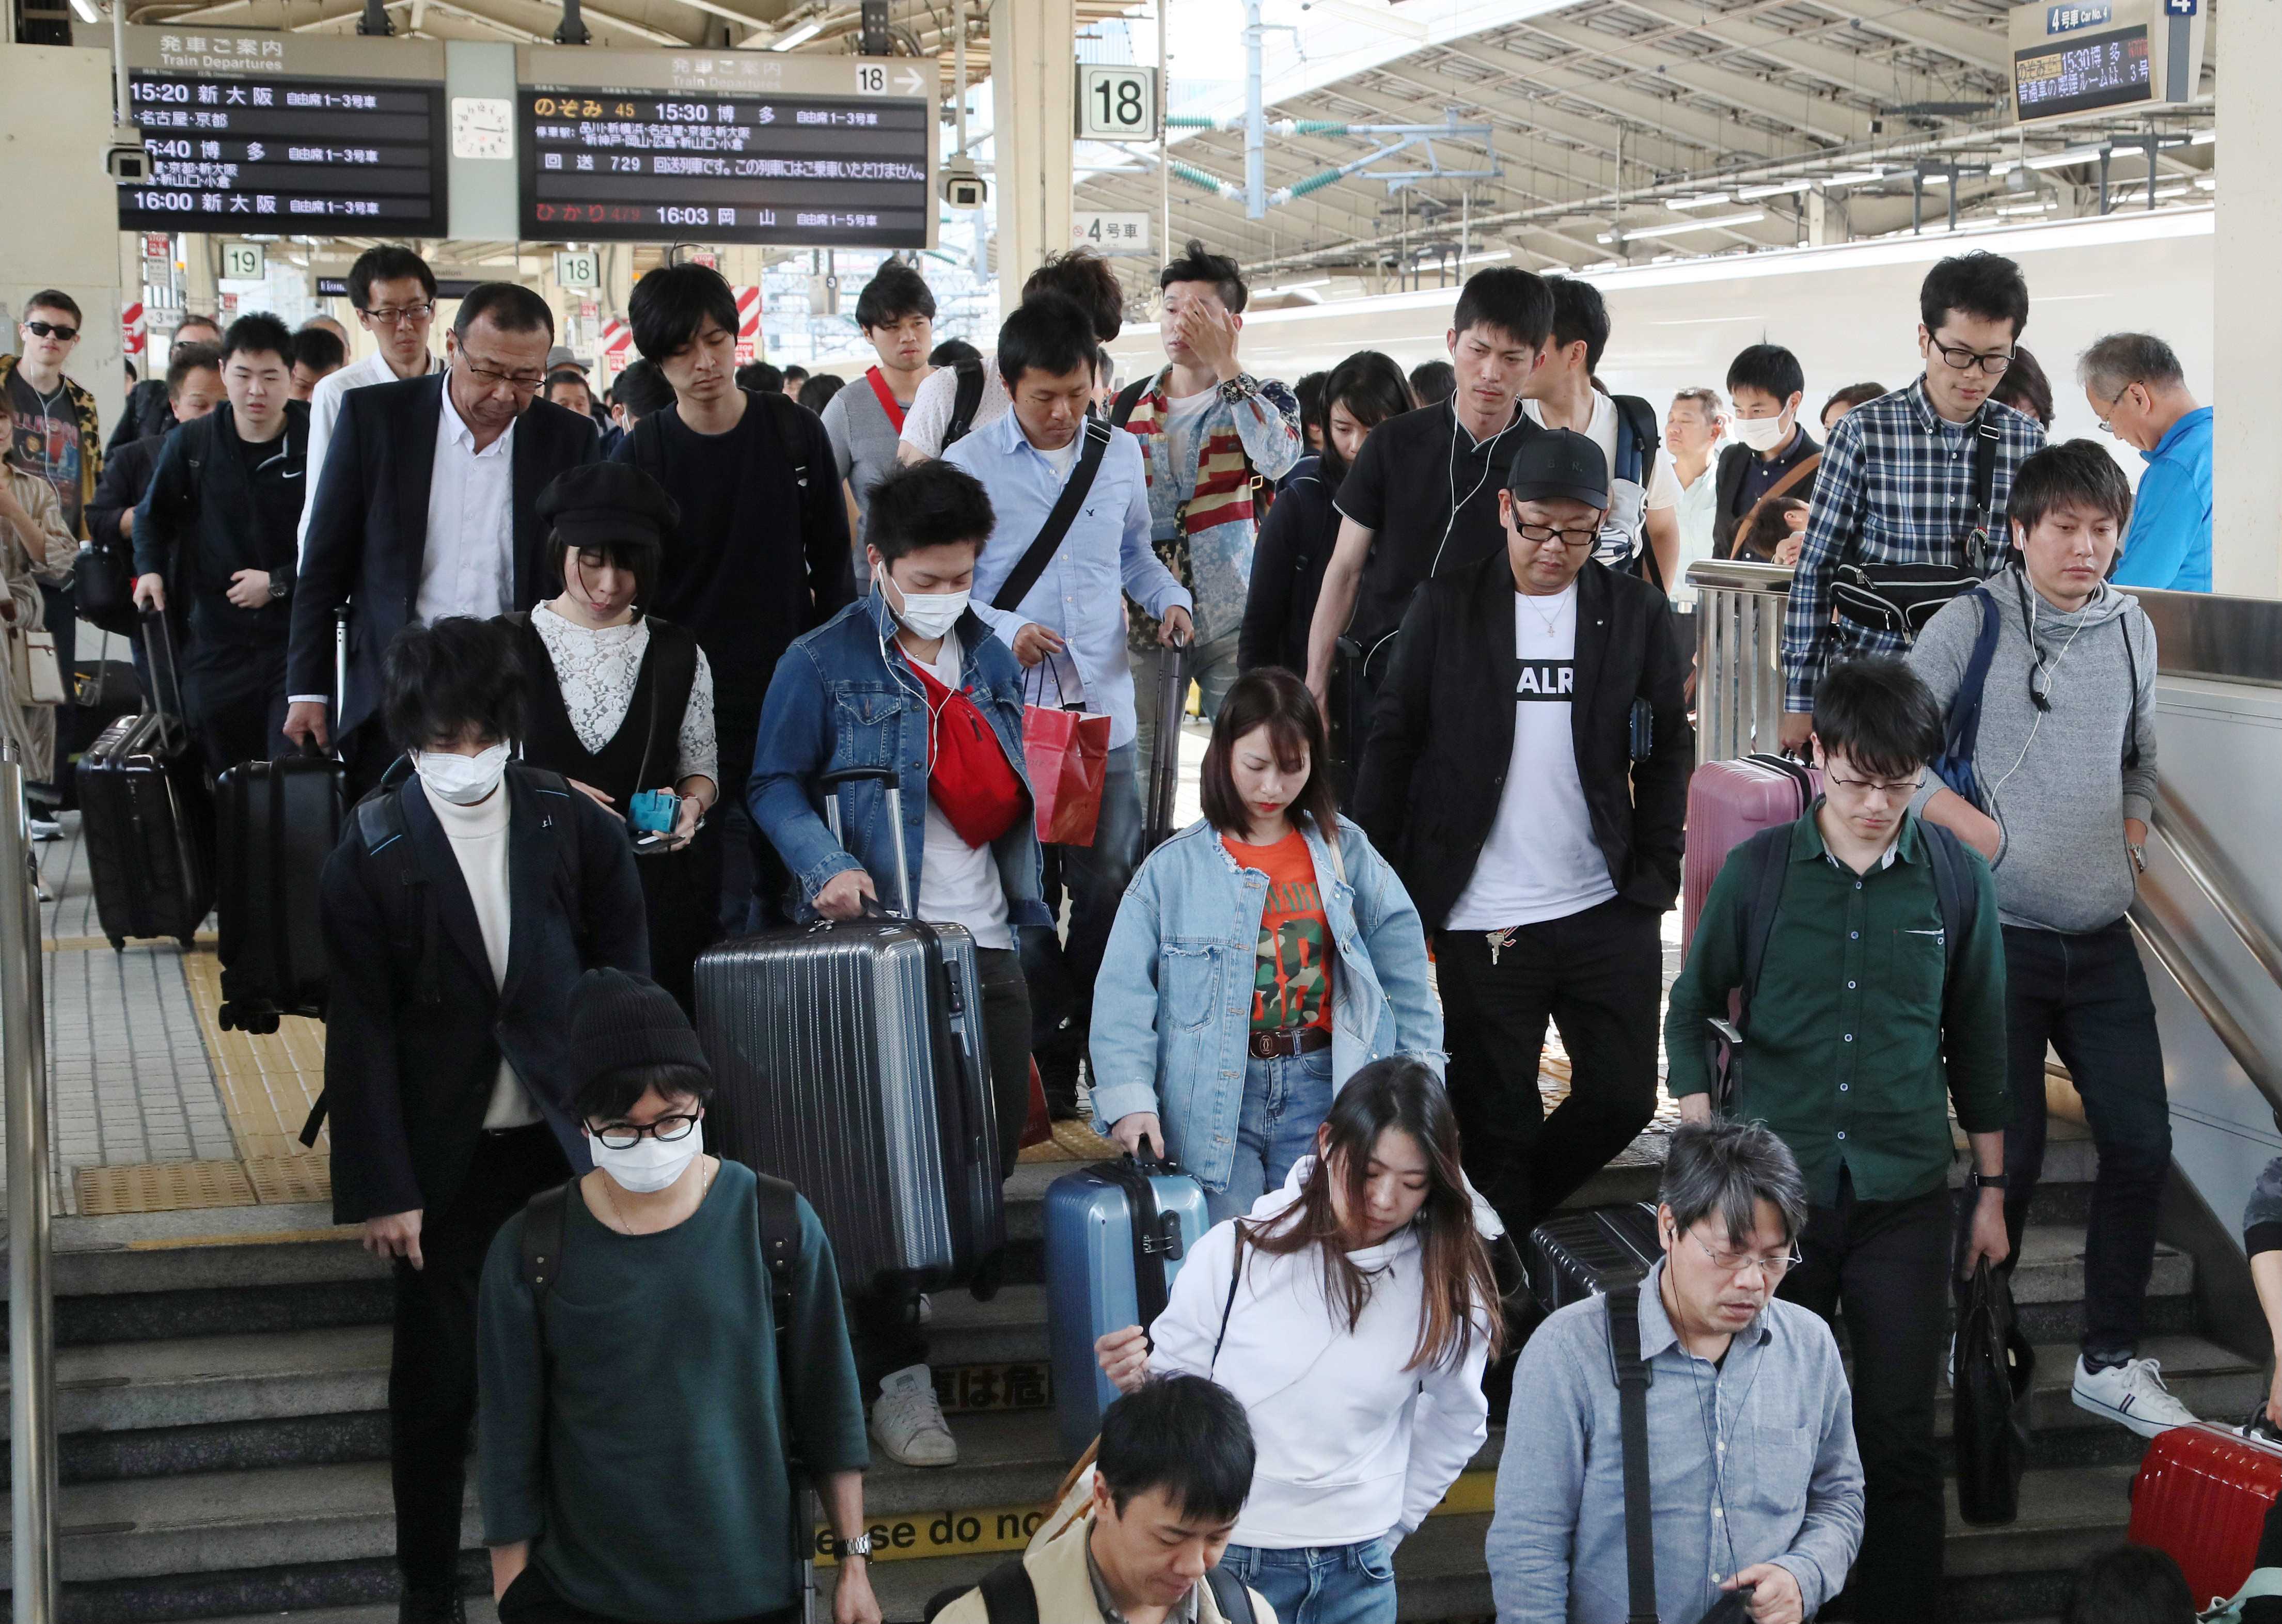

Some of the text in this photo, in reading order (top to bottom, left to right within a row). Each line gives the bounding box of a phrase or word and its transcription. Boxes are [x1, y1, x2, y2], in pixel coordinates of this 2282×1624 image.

[2081, 12, 2091, 23] Car
[2092, 10, 2102, 21] No.
[2103, 8, 2107, 18] 4
[161, 35, 282, 58] 発車ご案内
[161, 54, 282, 70] Train Departures
[673, 75, 705, 88] Train
[859, 68, 884, 91] 18
[130, 83, 189, 103] 15:20
[1095, 79, 1142, 125] 18
[534, 98, 603, 118] のぞみ
[615, 103, 636, 118] 45
[655, 103, 709, 122] 15:30
[145, 139, 192, 158] 5:40
[610, 156, 641, 172] 729
[134, 192, 193, 211] 16:00
[537, 203, 605, 223] ひかり
[657, 207, 709, 226] 16:03
[230, 251, 256, 273] 19
[566, 259, 590, 280] 18
[908, 258, 917, 270] 4
[828, 277, 836, 288] 3
[1548, 459, 1583, 472] BR.
[816, 1520, 916, 1555] ese
[930, 1511, 982, 1546] do
